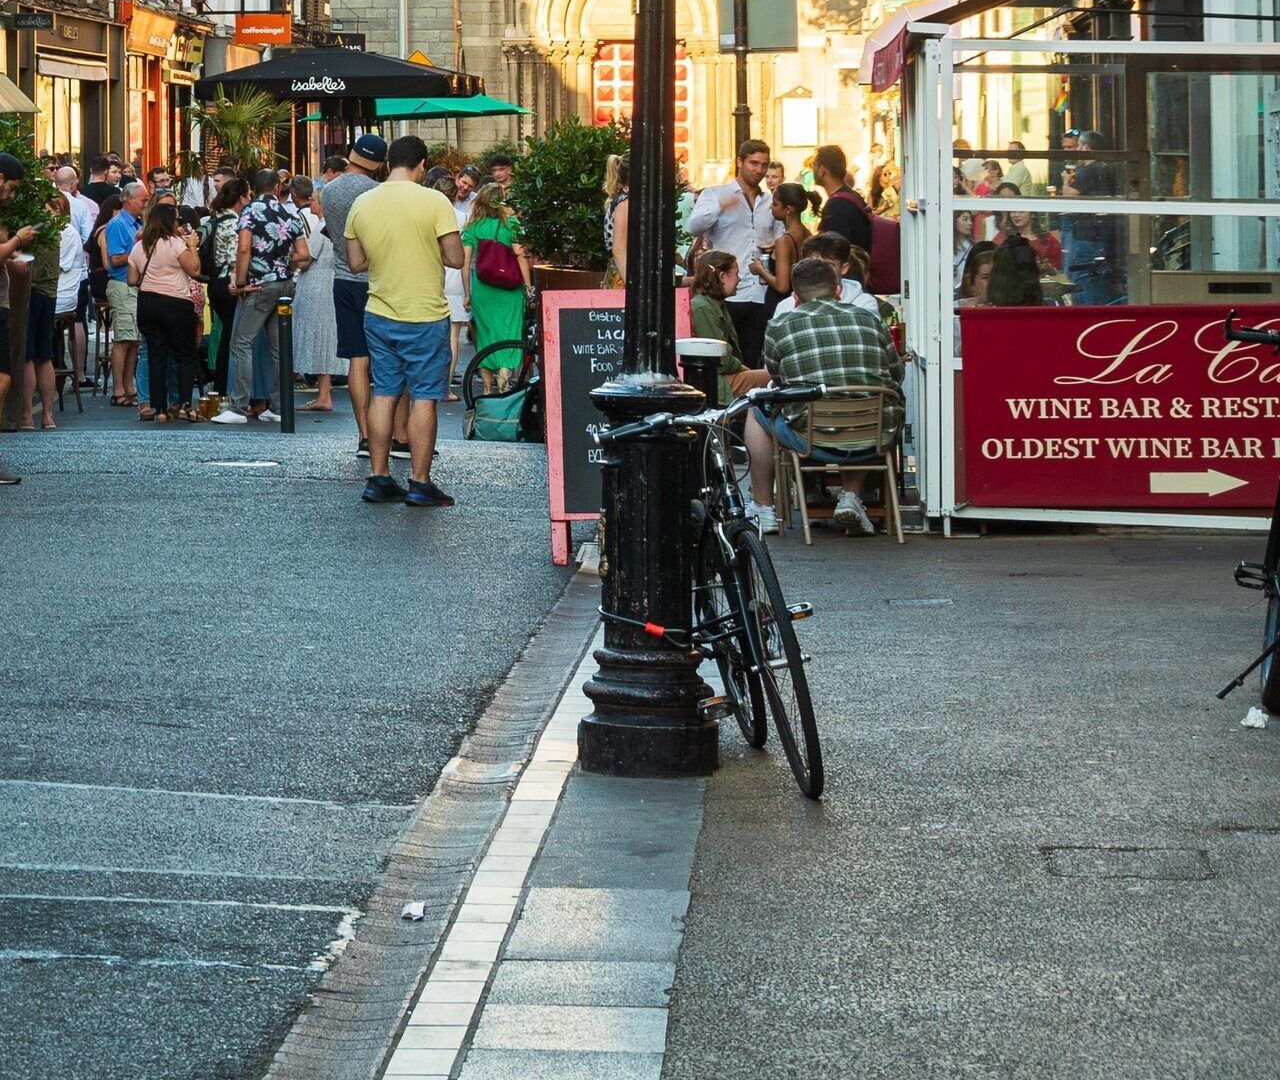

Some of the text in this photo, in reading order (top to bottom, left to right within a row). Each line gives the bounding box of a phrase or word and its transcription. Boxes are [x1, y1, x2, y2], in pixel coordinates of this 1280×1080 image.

[291, 76, 346, 94] isabelle's
[597, 328, 612, 340] LA
[597, 343, 618, 355] BAR
[1054, 319, 1179, 385] La
[1005, 397, 1280, 419] WINE BAR & REST
[981, 437, 1265, 460] OLDEST WINE BAR
